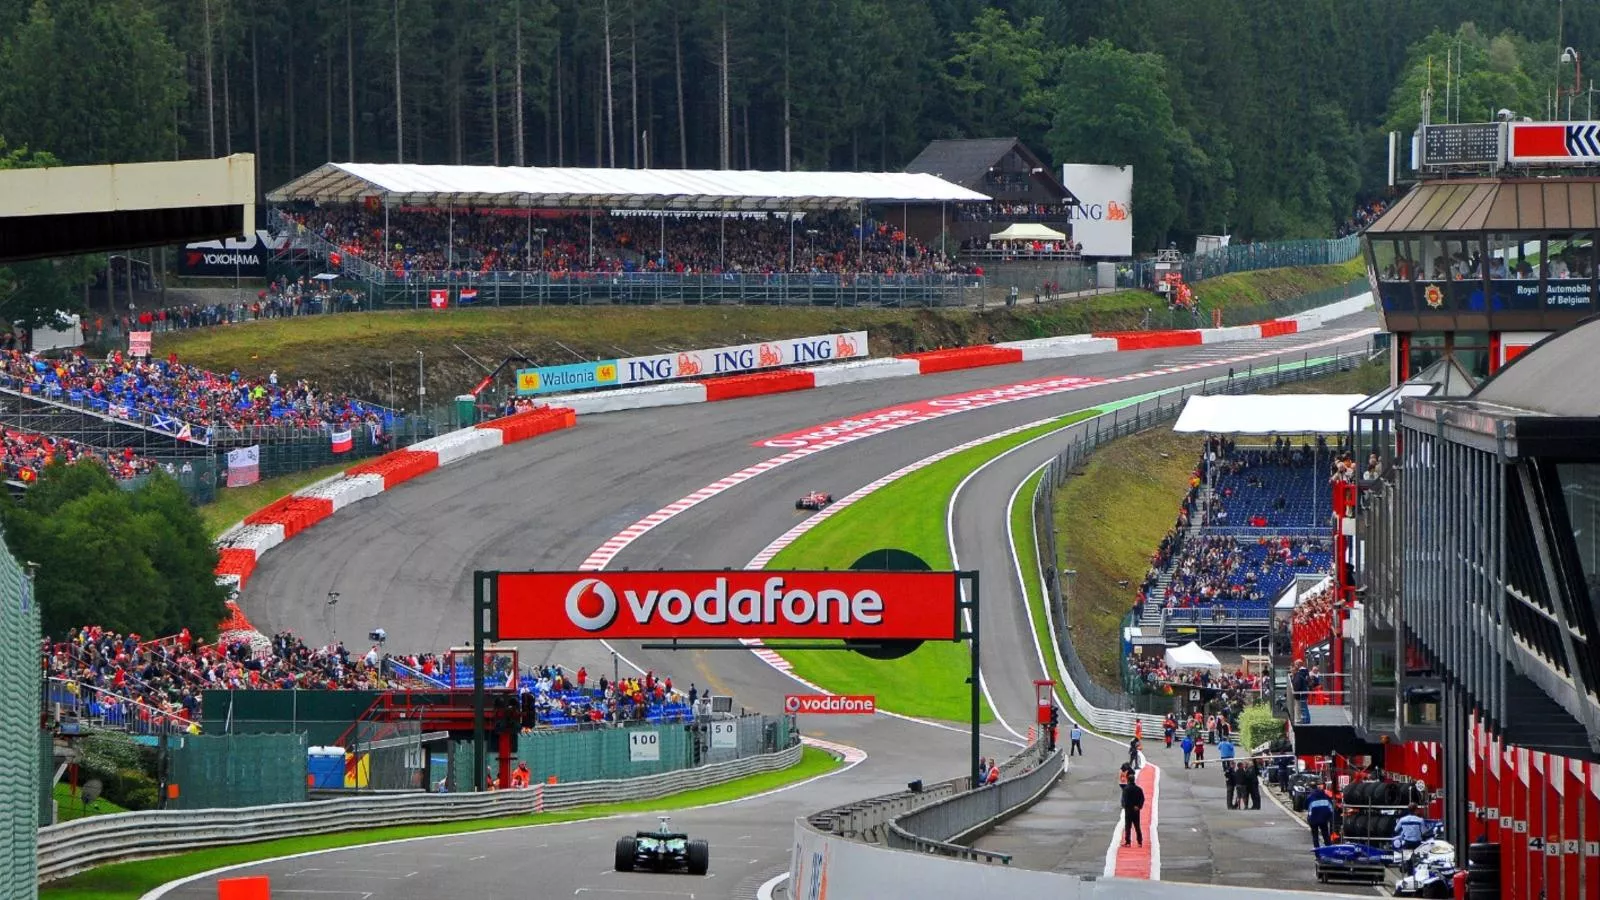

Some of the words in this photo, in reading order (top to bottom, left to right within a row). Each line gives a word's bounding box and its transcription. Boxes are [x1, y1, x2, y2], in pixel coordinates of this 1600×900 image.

[203, 254, 260, 265] YOKOHAMA
[1517, 285, 1539, 296] Royal
[1547, 284, 1591, 293] Automobile
[1547, 296, 1556, 304] of
[1558, 296, 1590, 306] Belgium
[629, 359, 672, 382] ING
[714, 350, 754, 372] ING
[793, 341, 832, 362] ING
[541, 370, 595, 387] Wallonia
[624, 577, 883, 623] vodafone
[801, 697, 873, 712] vodafone
[632, 735, 657, 745] 100
[1529, 838, 1543, 849] 4
[1568, 841, 1575, 851] 2
[1550, 845, 1557, 854] 3
